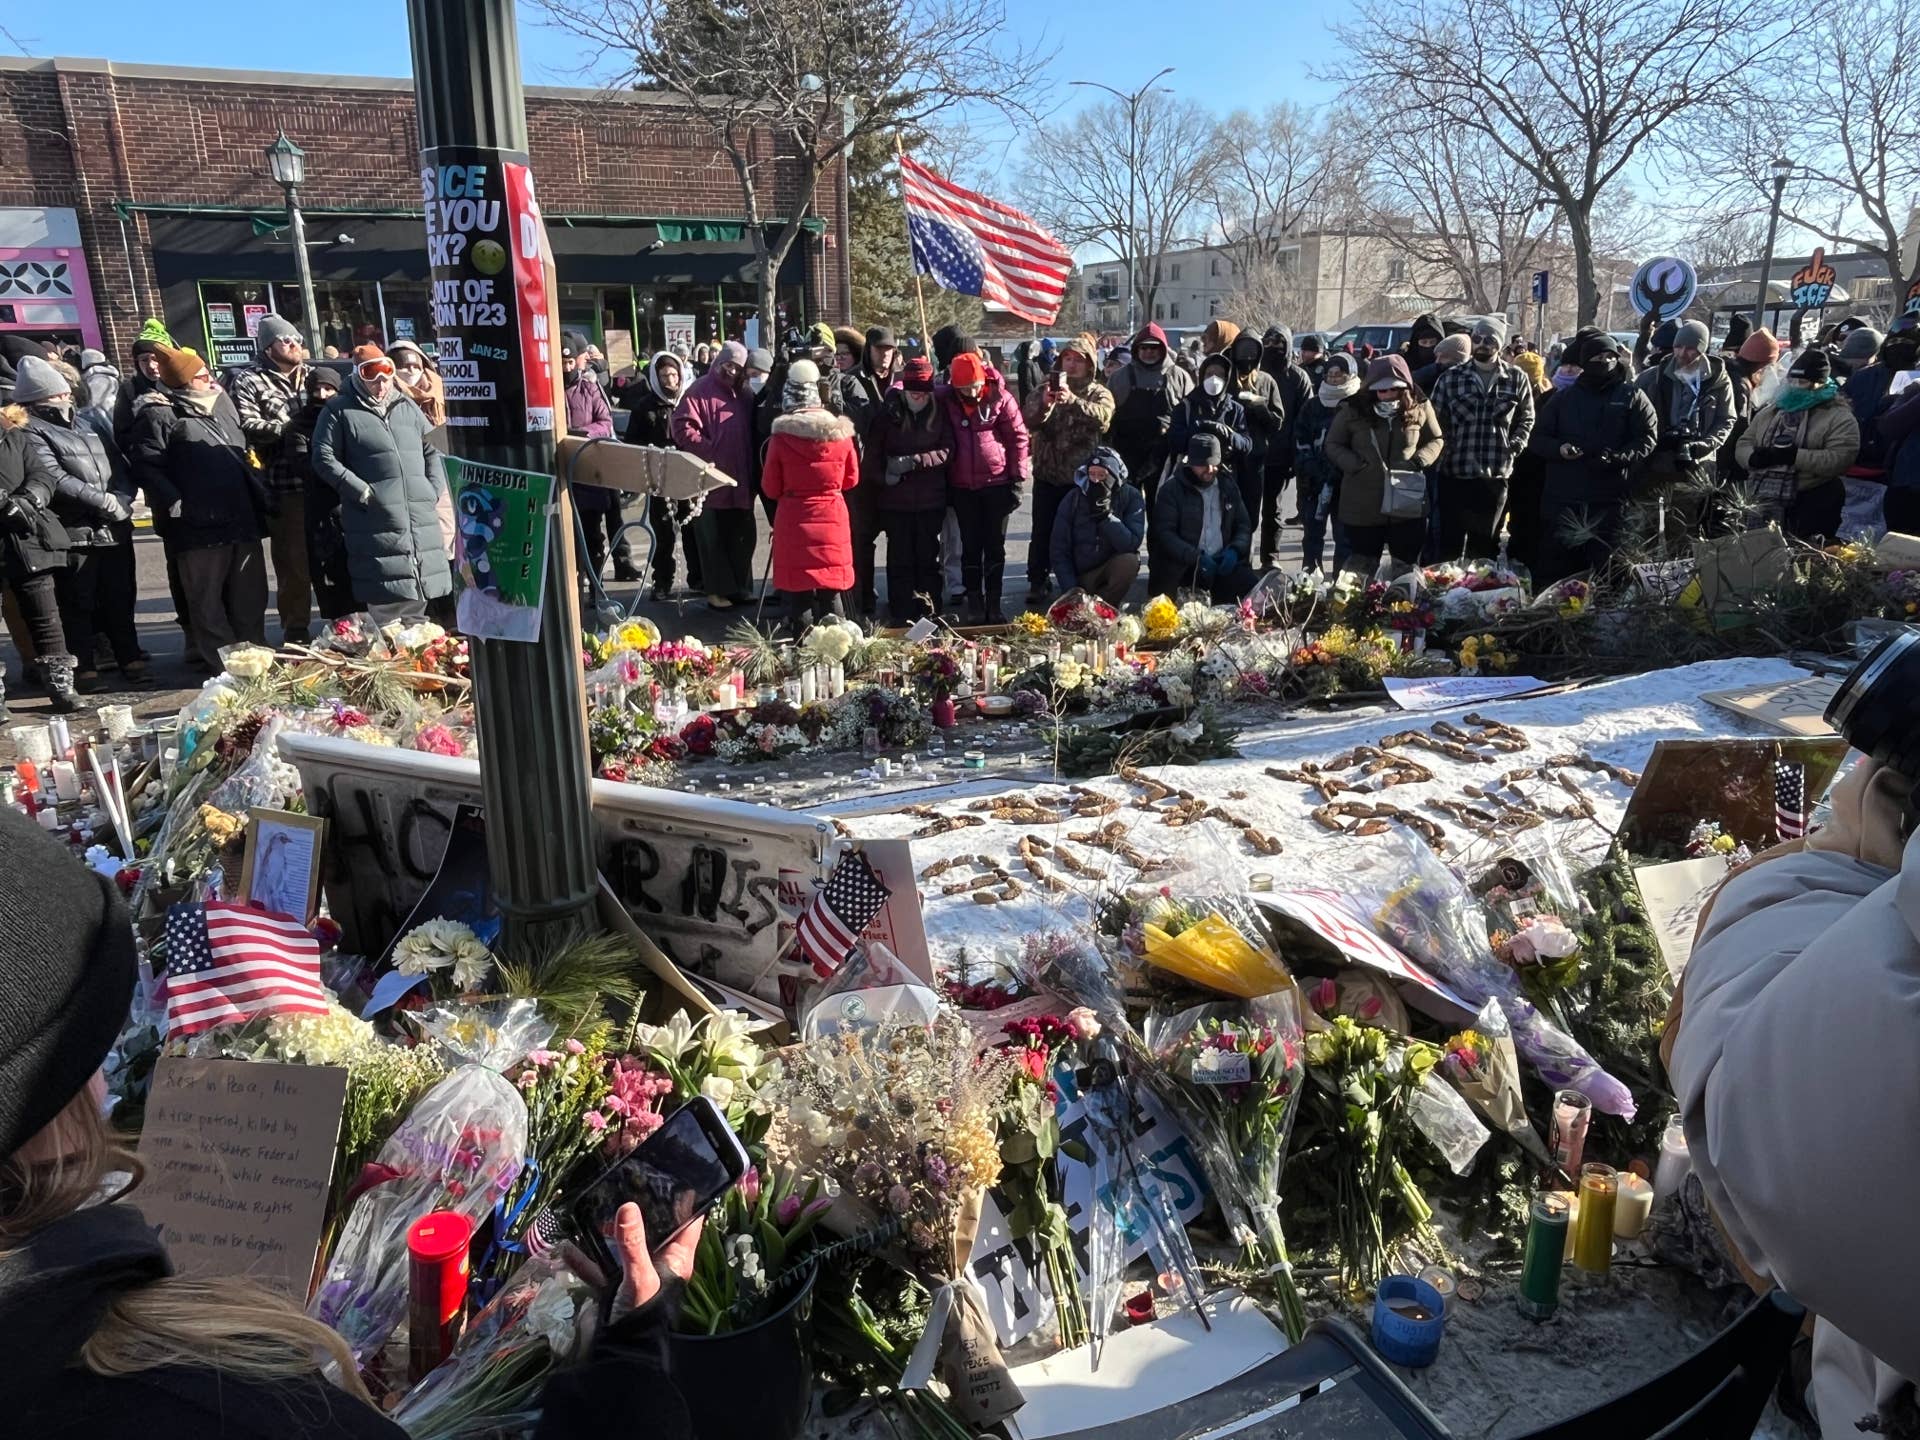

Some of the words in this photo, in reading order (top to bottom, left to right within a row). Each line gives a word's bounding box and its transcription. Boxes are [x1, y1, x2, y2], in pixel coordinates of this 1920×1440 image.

[438, 164, 487, 198] ICE
[440, 199, 500, 232] YOU
[1793, 247, 1835, 289] FUCK
[464, 279, 494, 303] OF
[1793, 283, 1830, 308] ICE
[458, 302, 507, 327] 1/23
[469, 343, 492, 357] JAN
[492, 347, 508, 361] 23
[460, 463, 528, 491] INNESOTA
